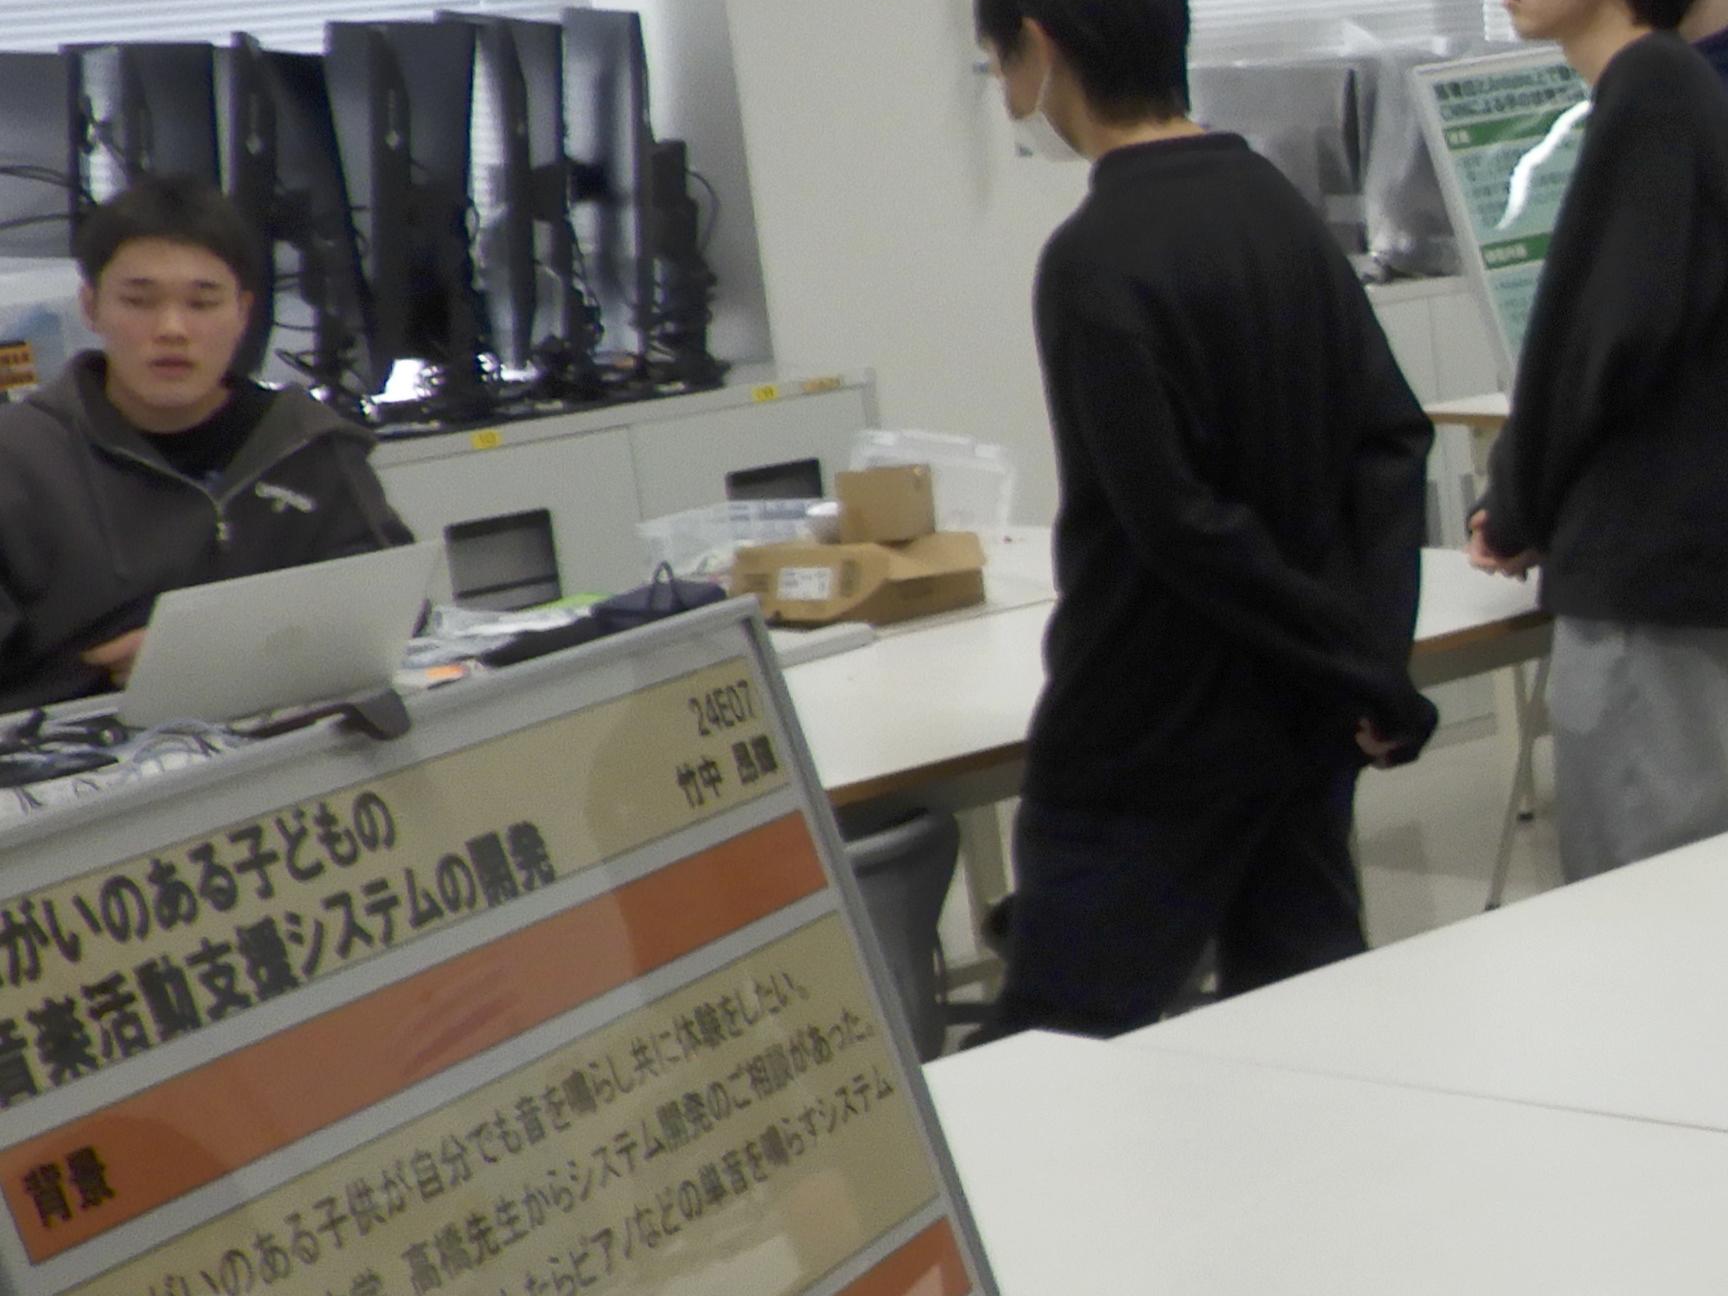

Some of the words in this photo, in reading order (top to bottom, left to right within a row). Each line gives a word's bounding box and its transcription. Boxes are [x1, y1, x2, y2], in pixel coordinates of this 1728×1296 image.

[689, 680, 760, 740] 24E07
[675, 753, 723, 809] 竹中
[0, 791, 395, 989] がいのある子どもの
[21, 1145, 115, 1230] 背景
